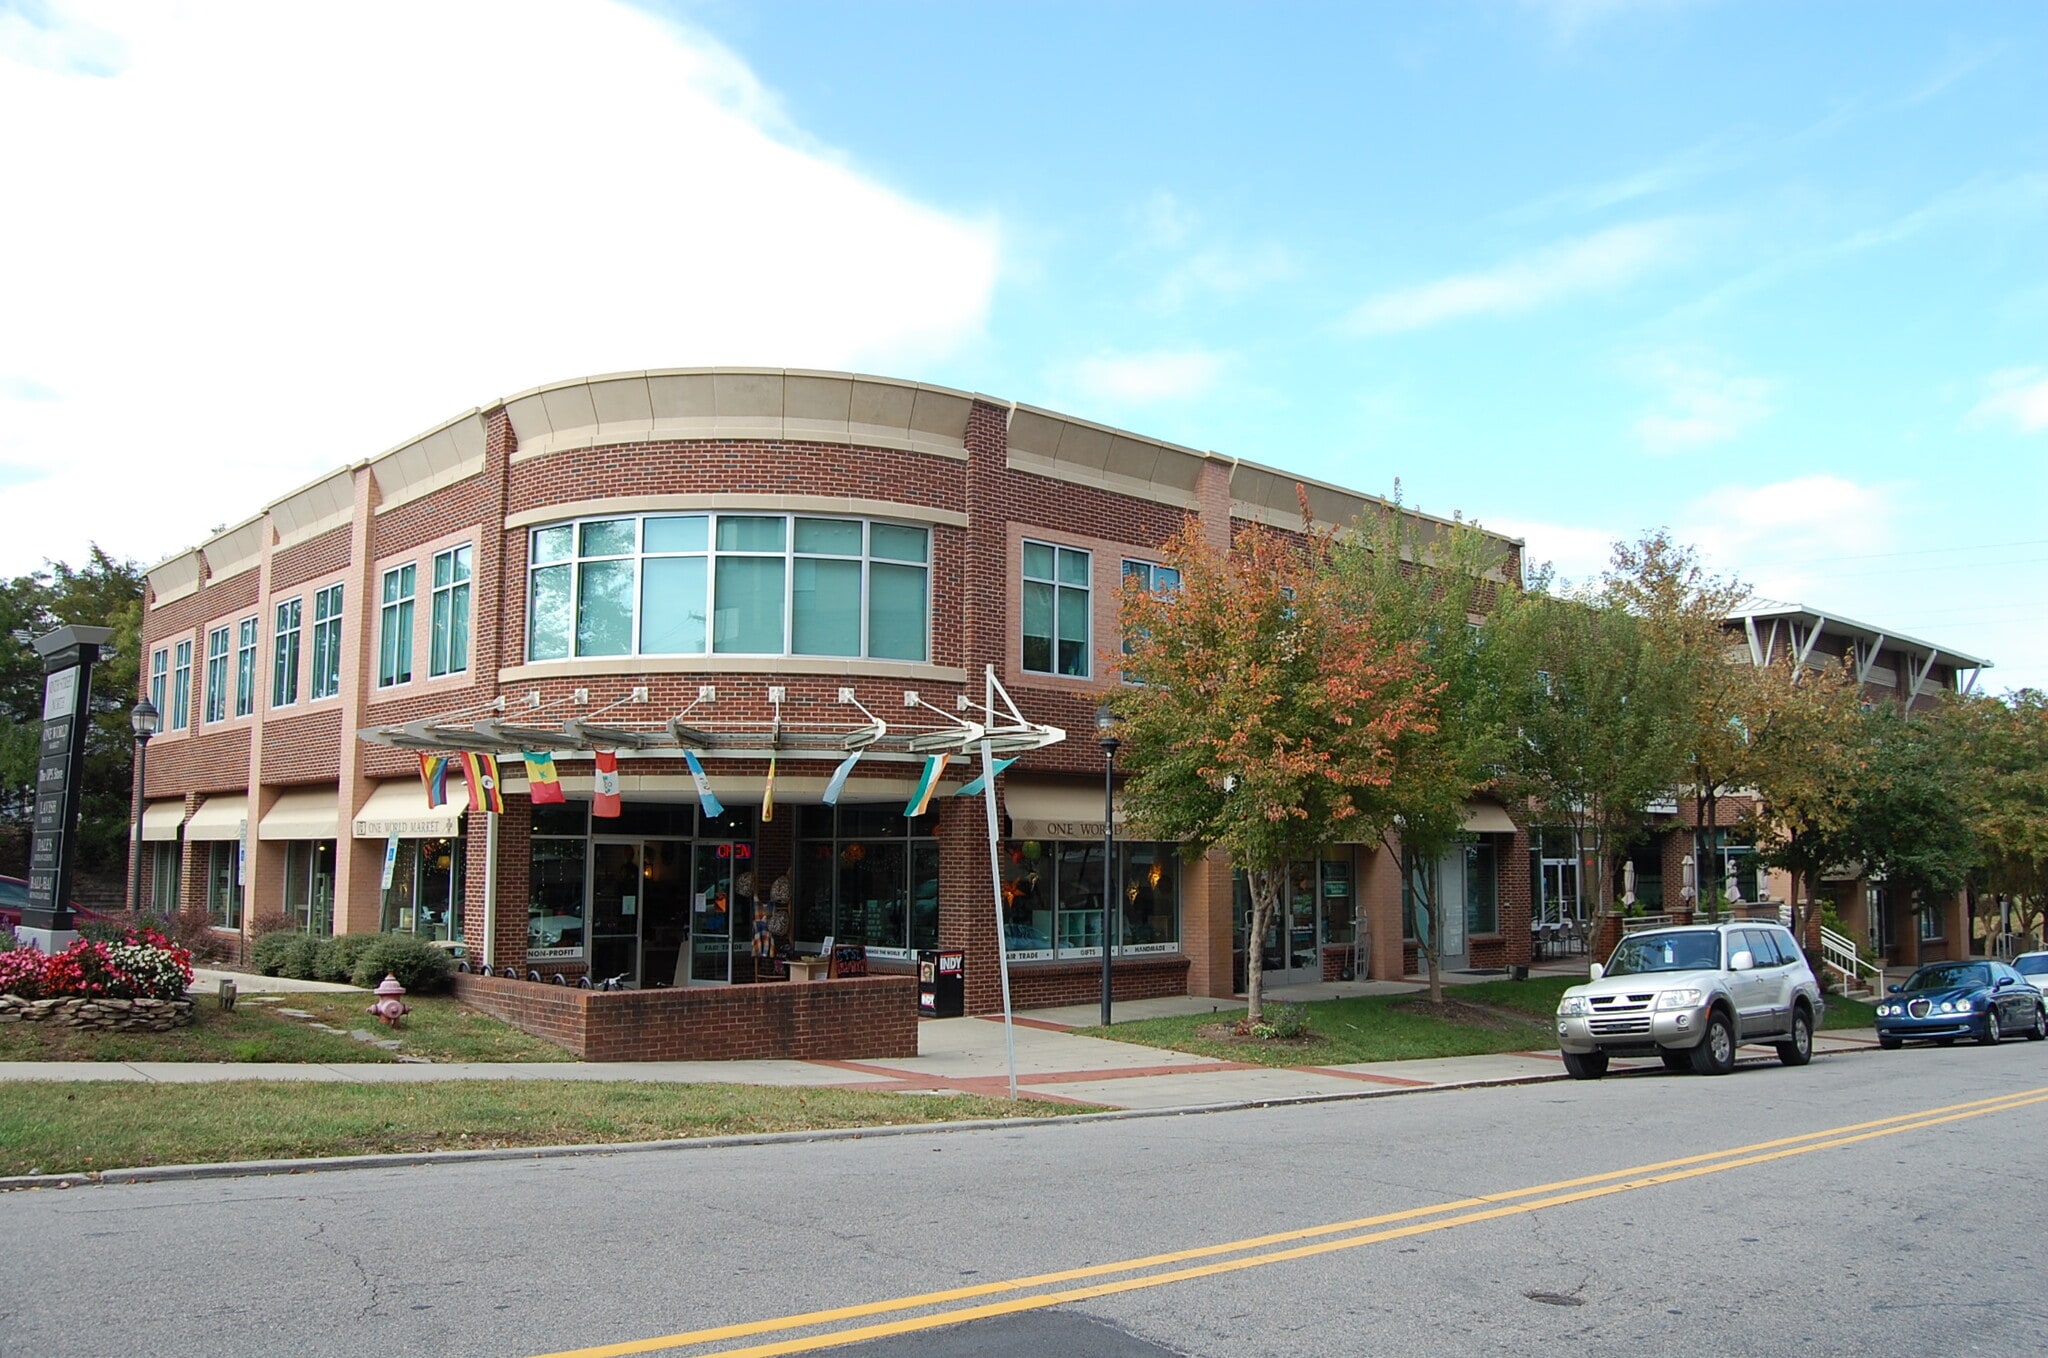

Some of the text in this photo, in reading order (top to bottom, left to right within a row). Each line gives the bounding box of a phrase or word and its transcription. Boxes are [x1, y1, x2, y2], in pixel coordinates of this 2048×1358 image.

[368, 821, 439, 833] ONE WORLD MARKET
[1047, 823, 1123, 836] ONE WORD
[717, 844, 751, 859] OPEN
[527, 949, 575, 958] NON-PROFIT
[1080, 948, 1096, 957] GIFTS
[1134, 944, 1166, 953] HANDMADE
[1019, 951, 1038, 960] TRADE
[940, 956, 963, 970] INDY
